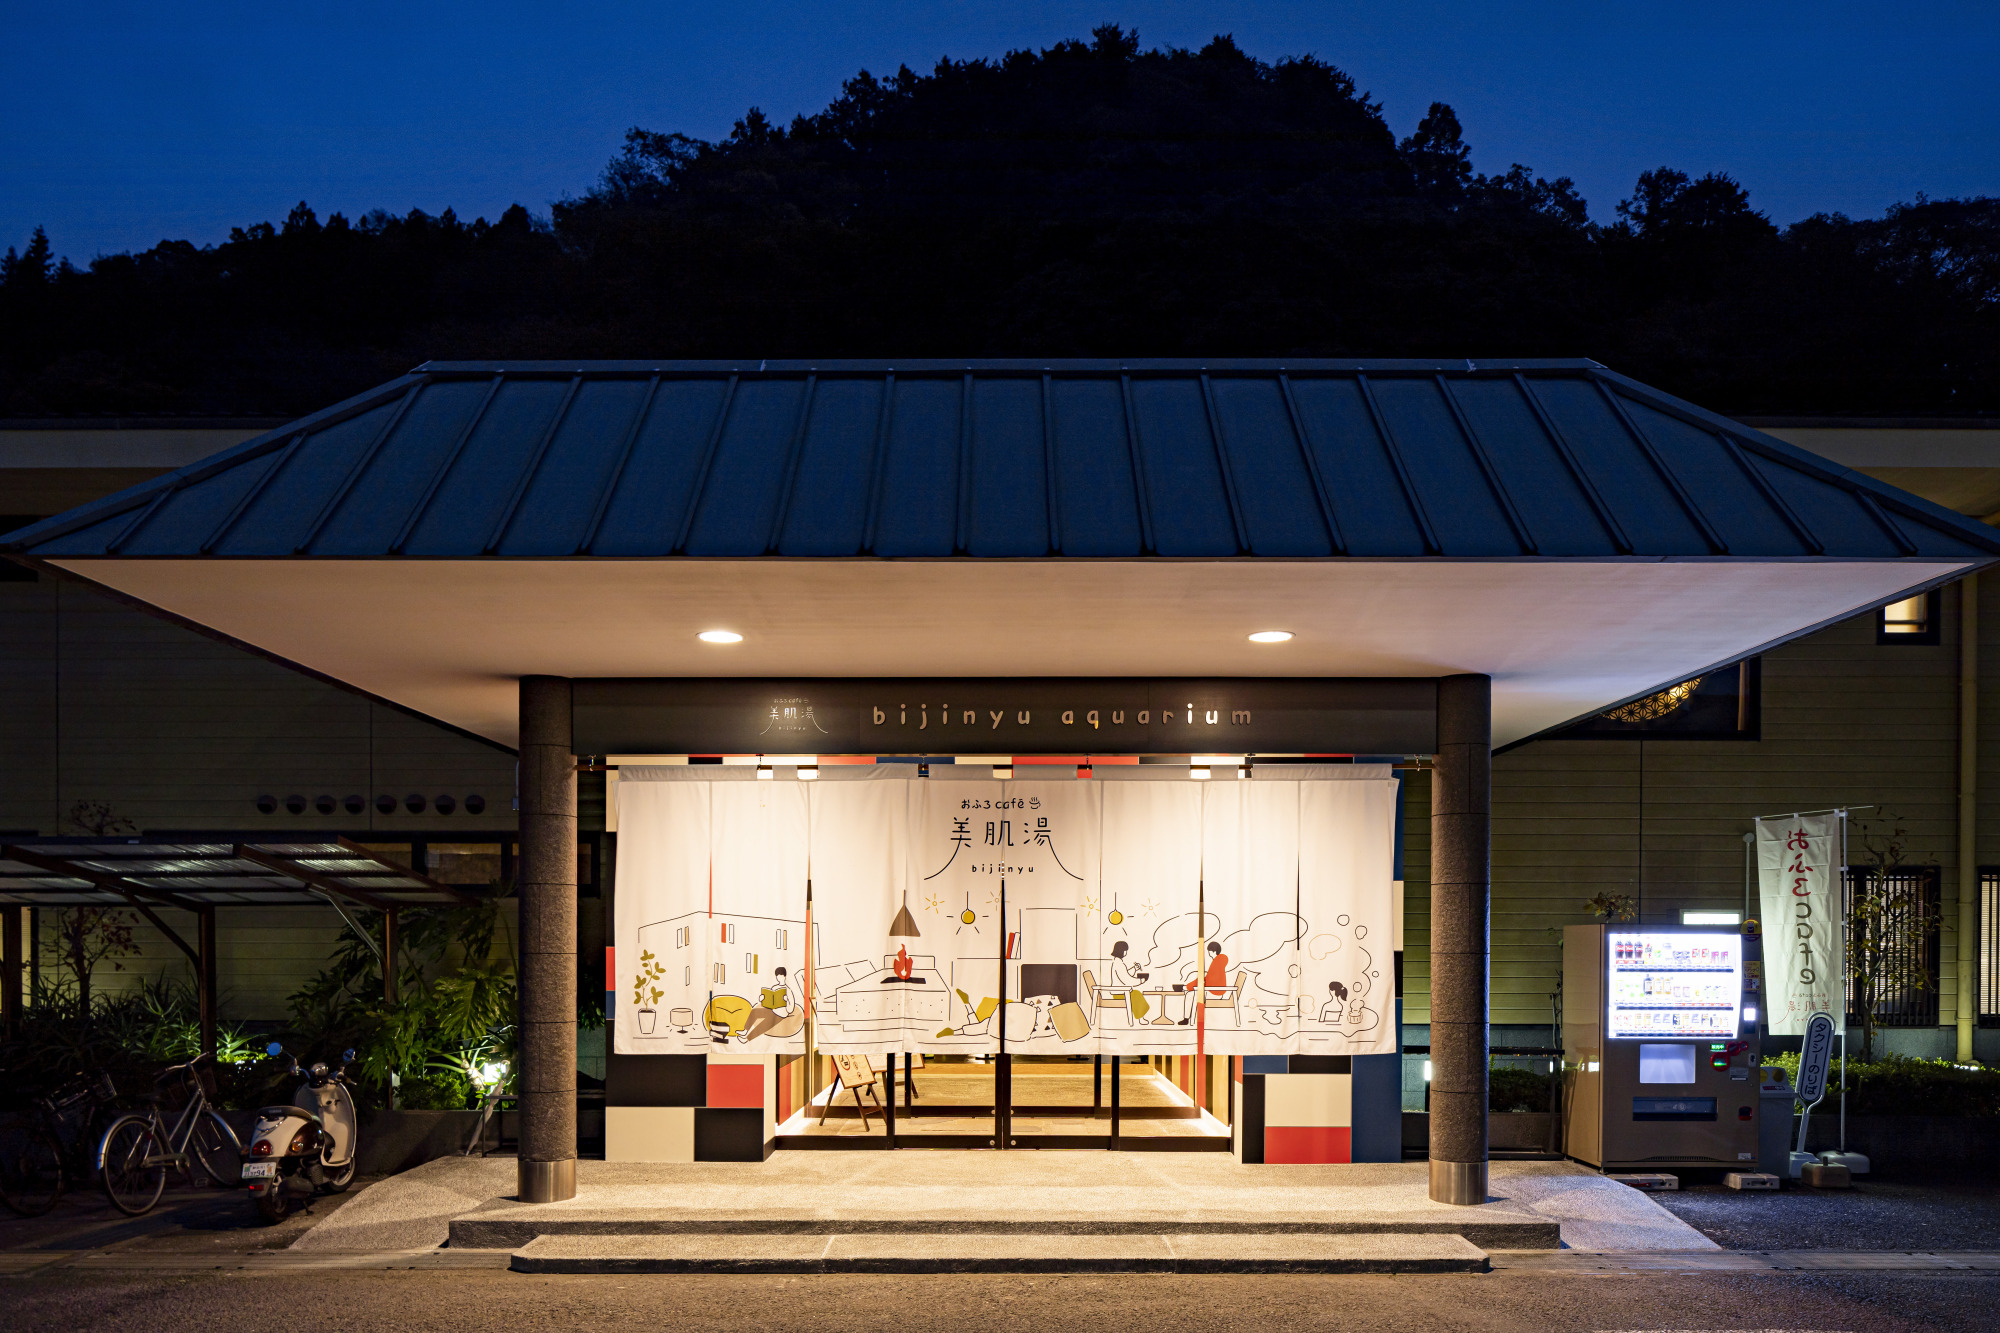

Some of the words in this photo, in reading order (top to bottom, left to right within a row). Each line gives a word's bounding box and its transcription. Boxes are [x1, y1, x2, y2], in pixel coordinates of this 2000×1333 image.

[873, 703, 1031, 730] bijinyu
[1061, 702, 1251, 730] aquarium
[950, 817, 1052, 848] 美肌湯
[971, 863, 1034, 874] bijinyu
[1804, 1022, 1827, 1095] タクシーのりば
